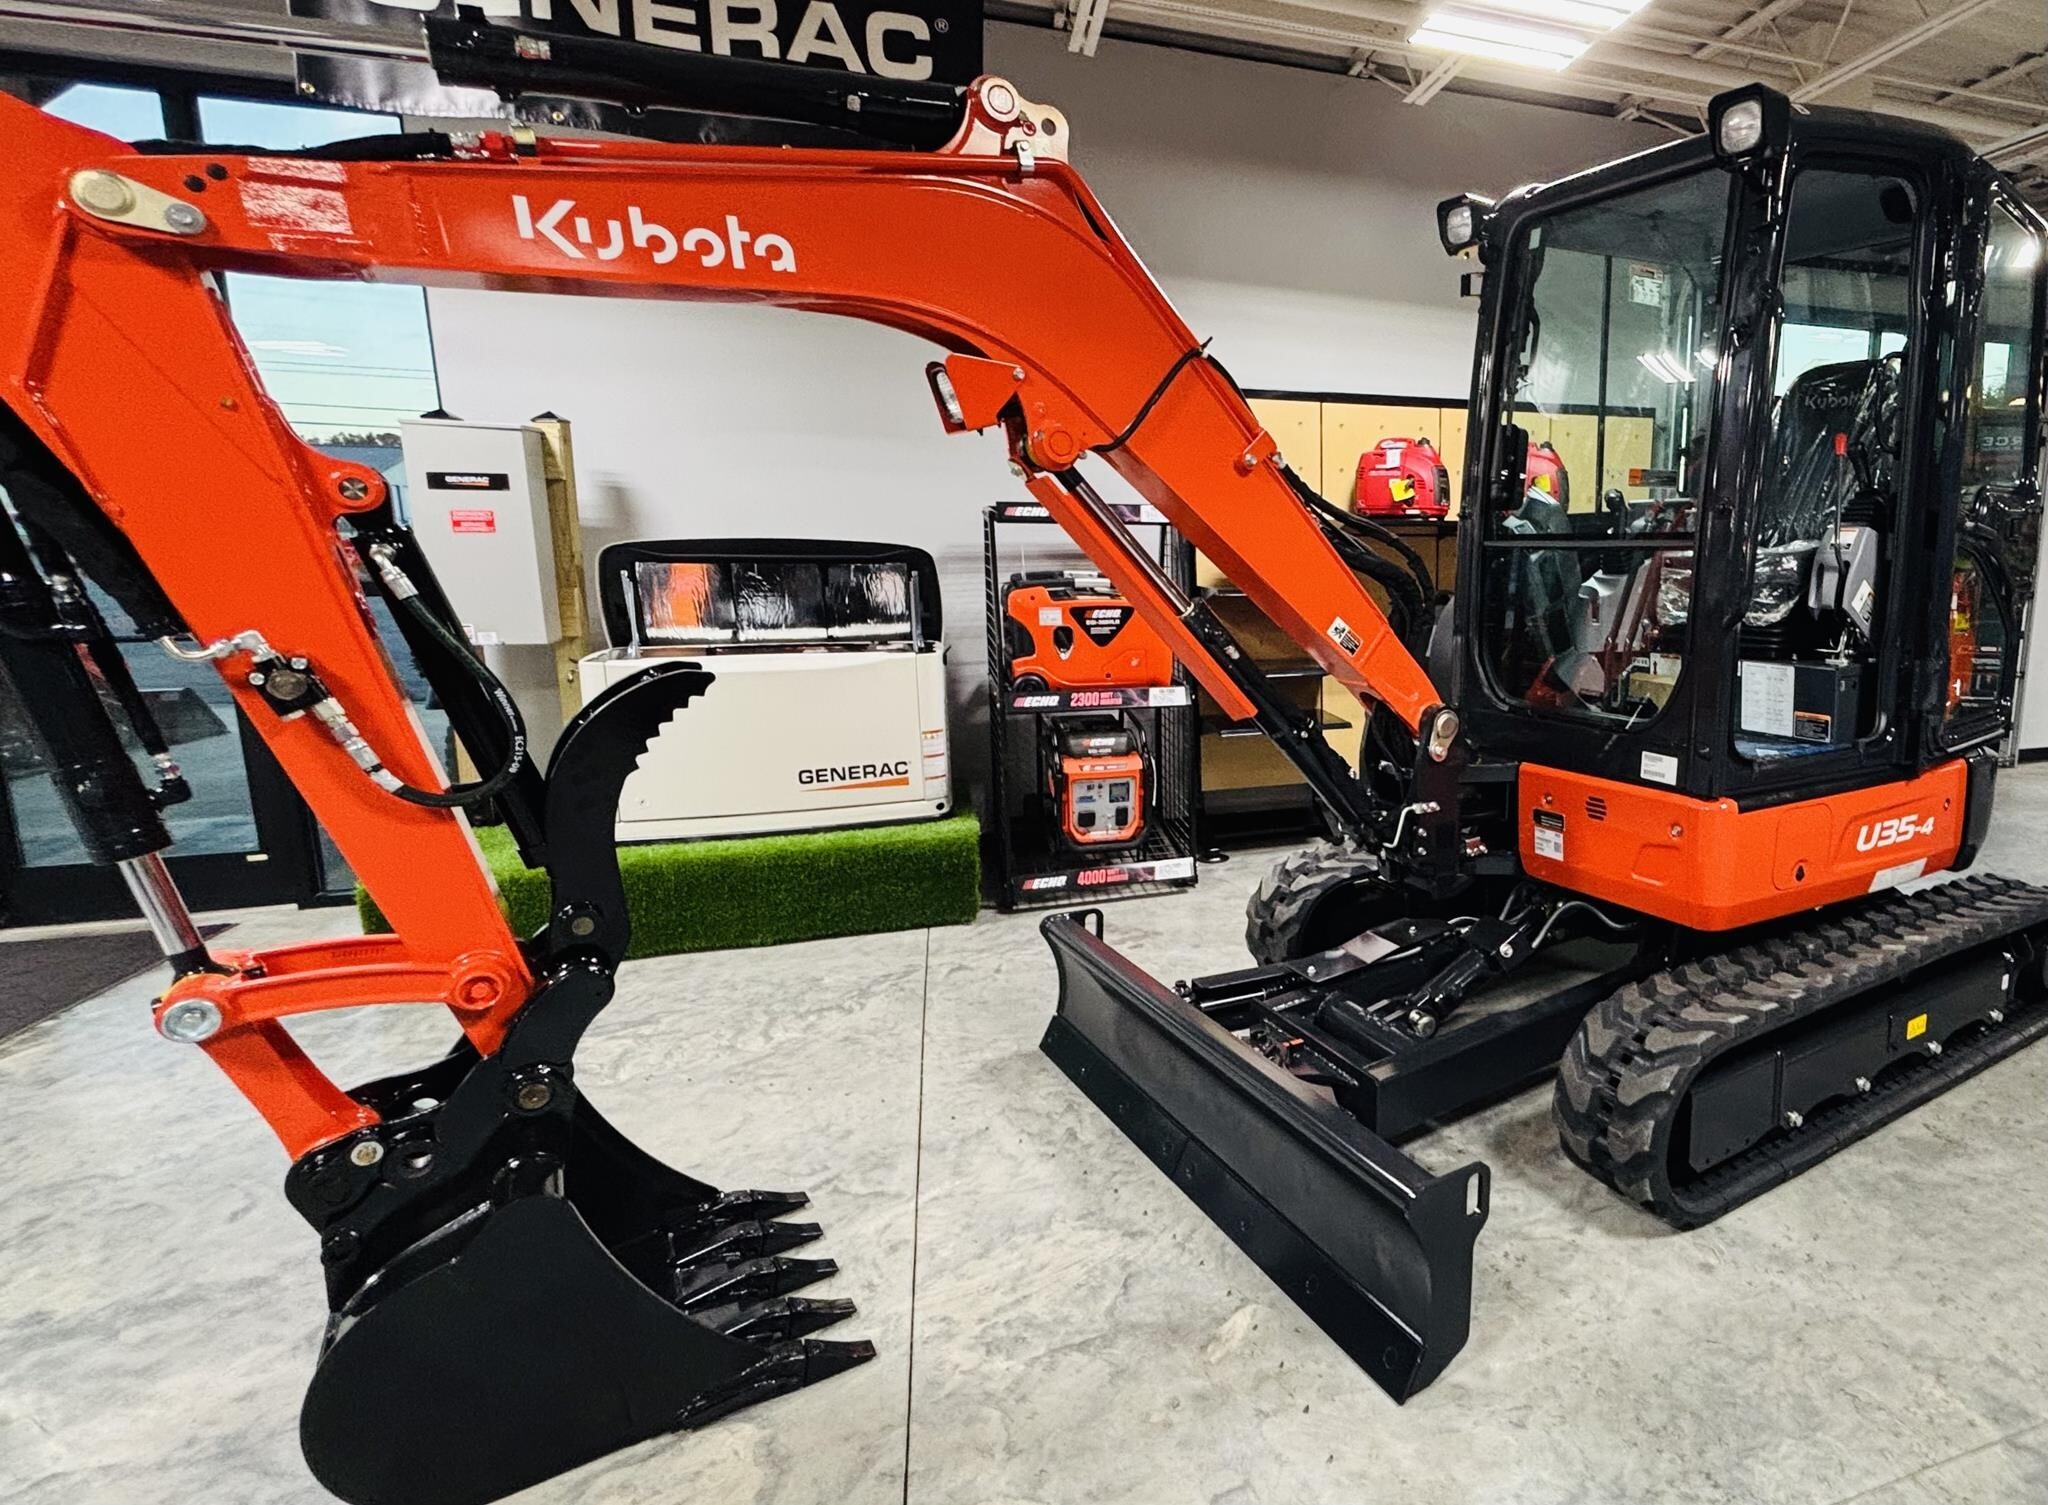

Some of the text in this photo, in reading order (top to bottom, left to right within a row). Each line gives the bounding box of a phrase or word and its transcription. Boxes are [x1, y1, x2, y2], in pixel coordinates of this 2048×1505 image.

[512, 194, 797, 273] Kubota
[1024, 695, 1060, 707] ECHO
[1070, 691, 1100, 708] 2300
[798, 761, 910, 785] GENERAC
[1855, 813, 1935, 853] U35-4
[1031, 875, 1068, 889] ECHO
[1077, 869, 1106, 886] 4000
